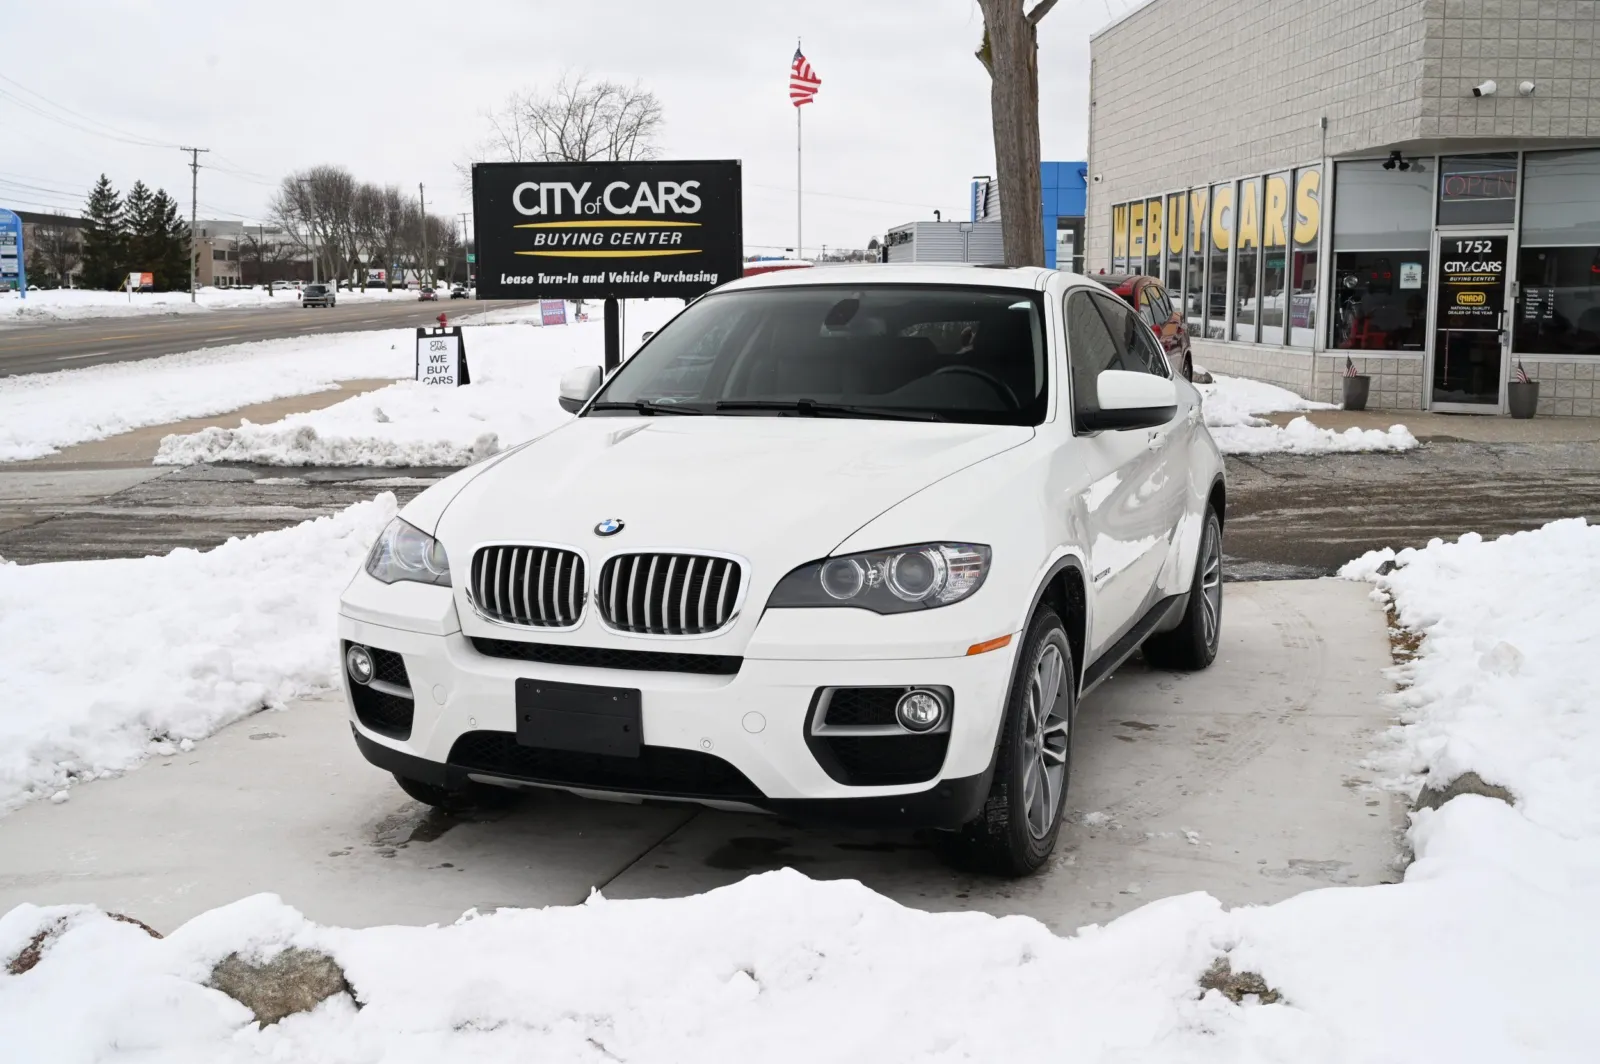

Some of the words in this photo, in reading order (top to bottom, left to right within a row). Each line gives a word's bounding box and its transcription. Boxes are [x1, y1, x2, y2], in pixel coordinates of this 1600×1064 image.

[1445, 173, 1514, 197] OPEN
[512, 181, 592, 216] CITY
[584, 196, 602, 215] of
[603, 180, 702, 215] CARS
[533, 232, 604, 246] BUYING
[610, 231, 683, 245] CENTER
[1456, 240, 1492, 253] 1752
[1444, 261, 1469, 272] CITY
[1471, 261, 1502, 272] CARS
[500, 273, 534, 285] Lease
[538, 272, 579, 284] Turn-In
[582, 271, 605, 284] and
[608, 271, 650, 283] Vehicle
[653, 270, 719, 285] Purchasing
[429, 354, 447, 363] WE
[427, 365, 450, 374] BUY
